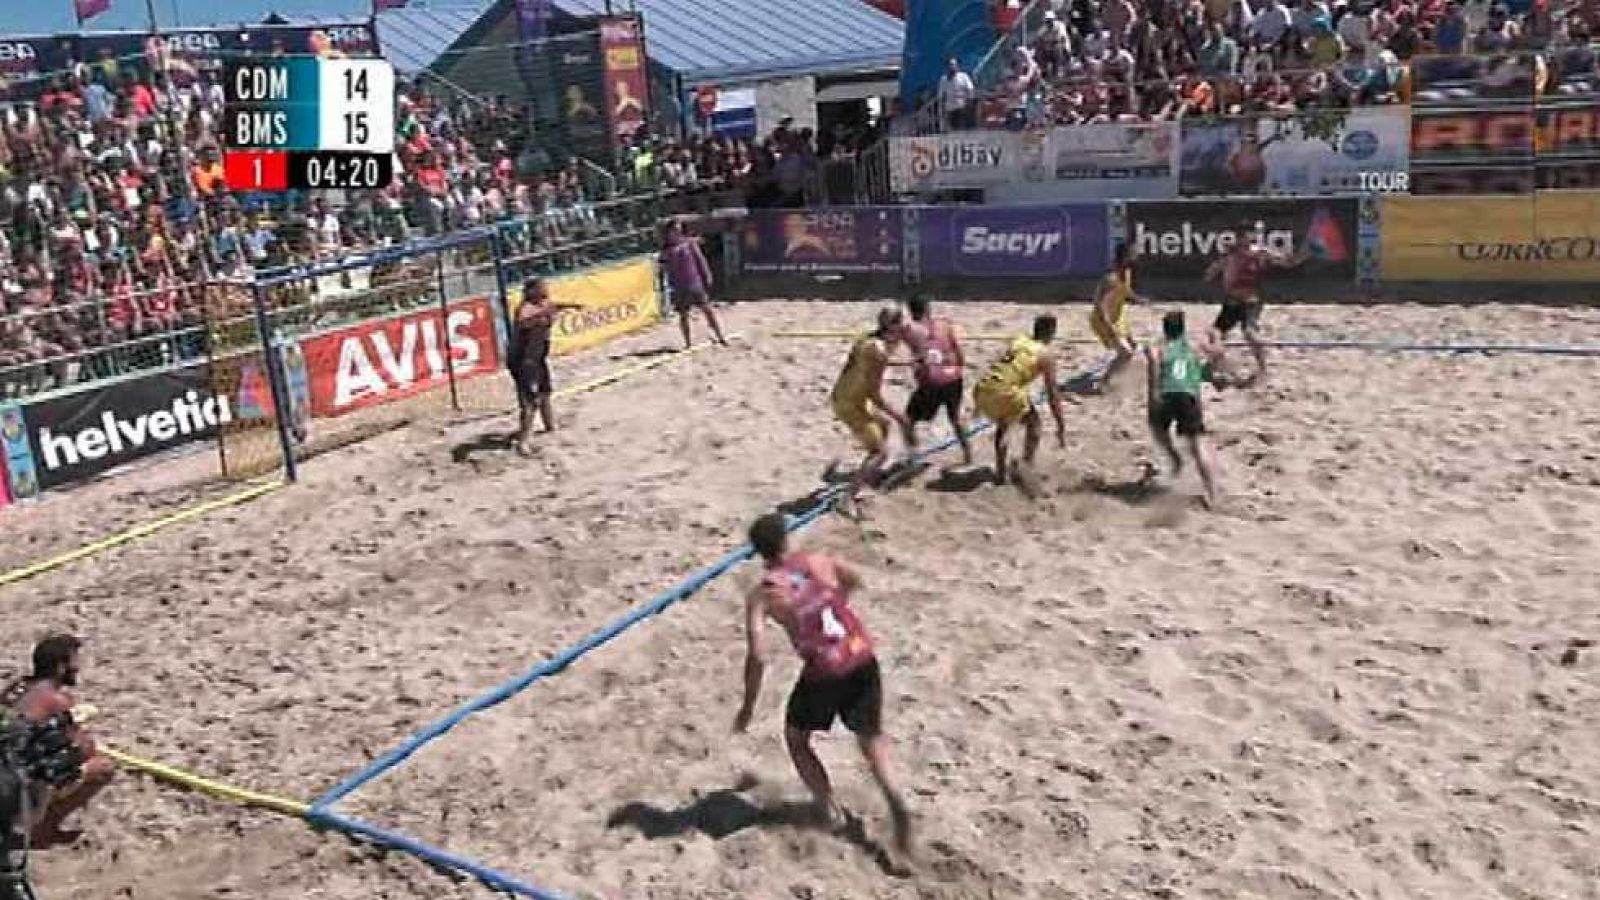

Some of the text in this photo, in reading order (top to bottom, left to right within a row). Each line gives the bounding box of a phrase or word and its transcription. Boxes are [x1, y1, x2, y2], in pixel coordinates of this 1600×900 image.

[962, 226, 1062, 256] Sacyr
[1135, 220, 1293, 257] helveia
[334, 311, 481, 406] AVIS
[39, 391, 232, 469] helvetia
